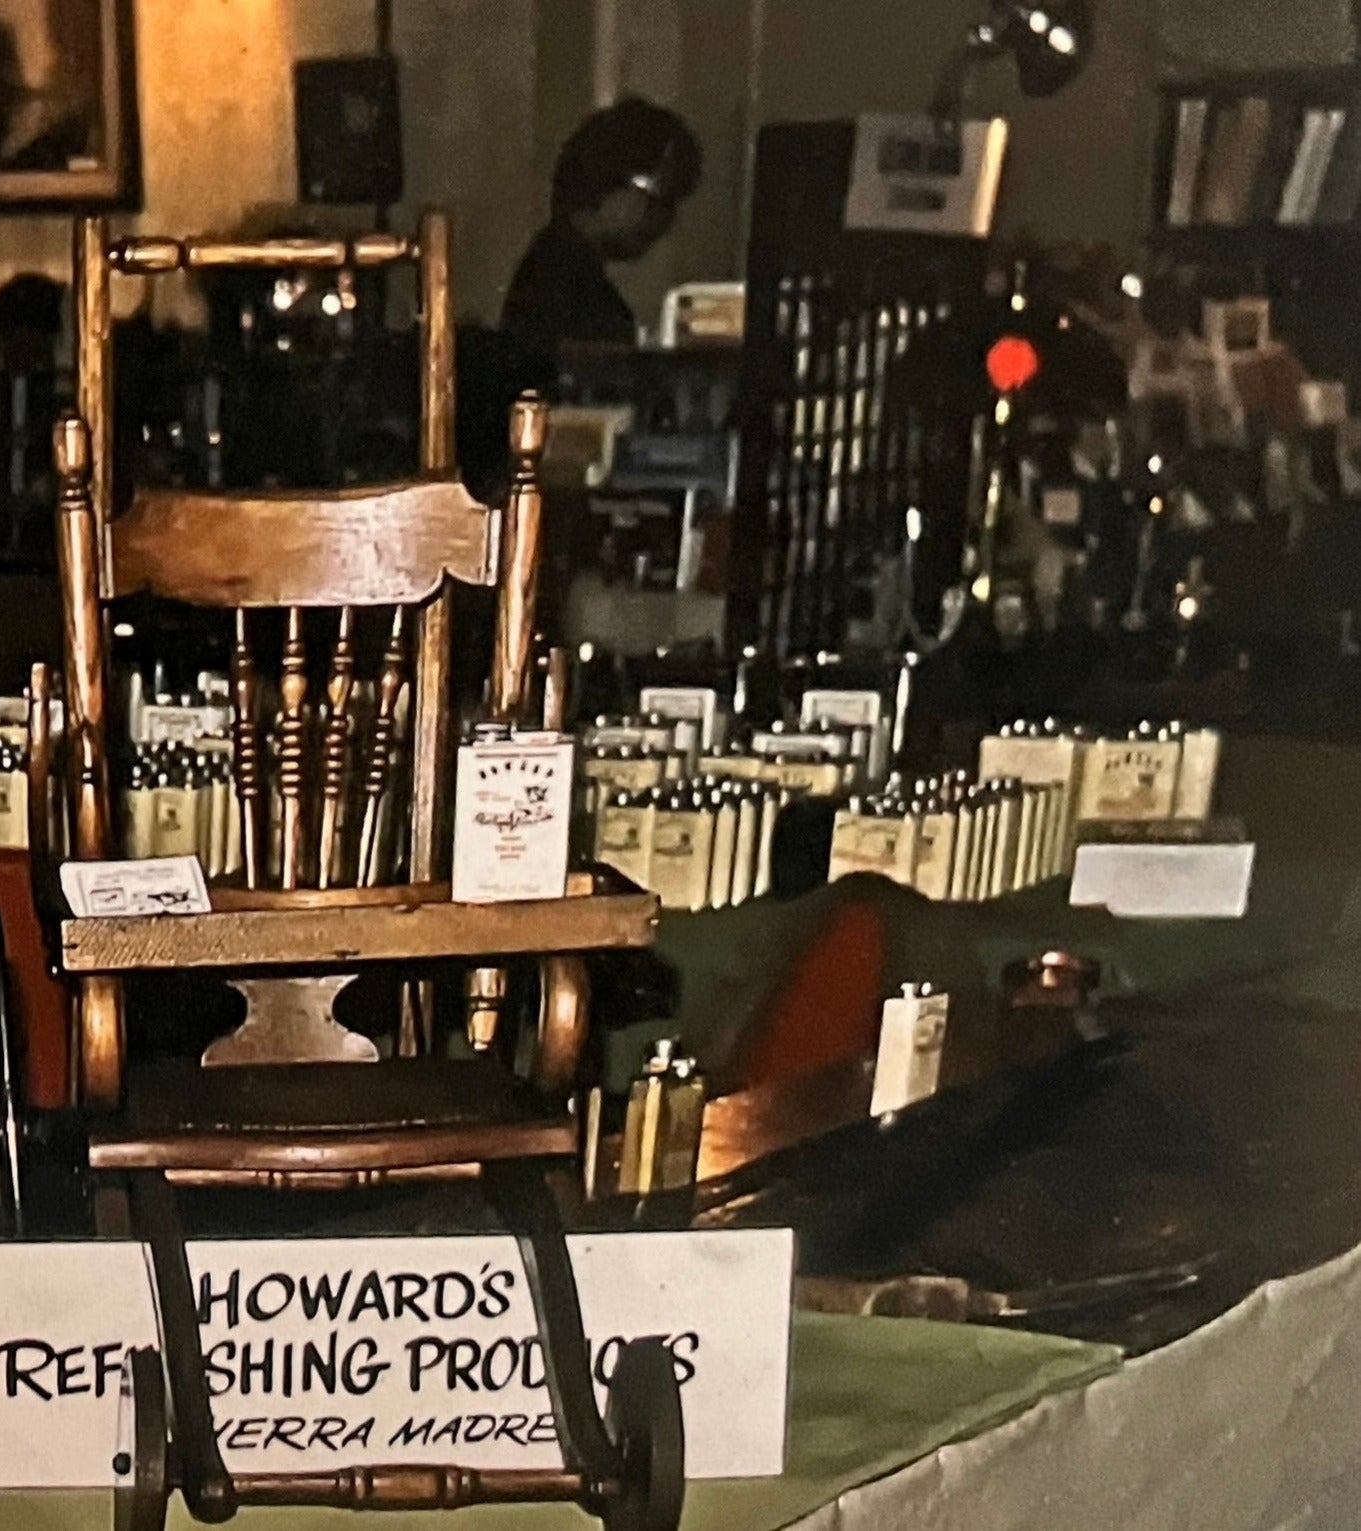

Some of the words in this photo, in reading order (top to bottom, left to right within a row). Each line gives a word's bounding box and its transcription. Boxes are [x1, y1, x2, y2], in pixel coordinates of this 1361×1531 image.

[196, 1262, 516, 1330] HOWARD'S
[212, 1416, 377, 1452] IERRA
[389, 1413, 559, 1447] MADRE
